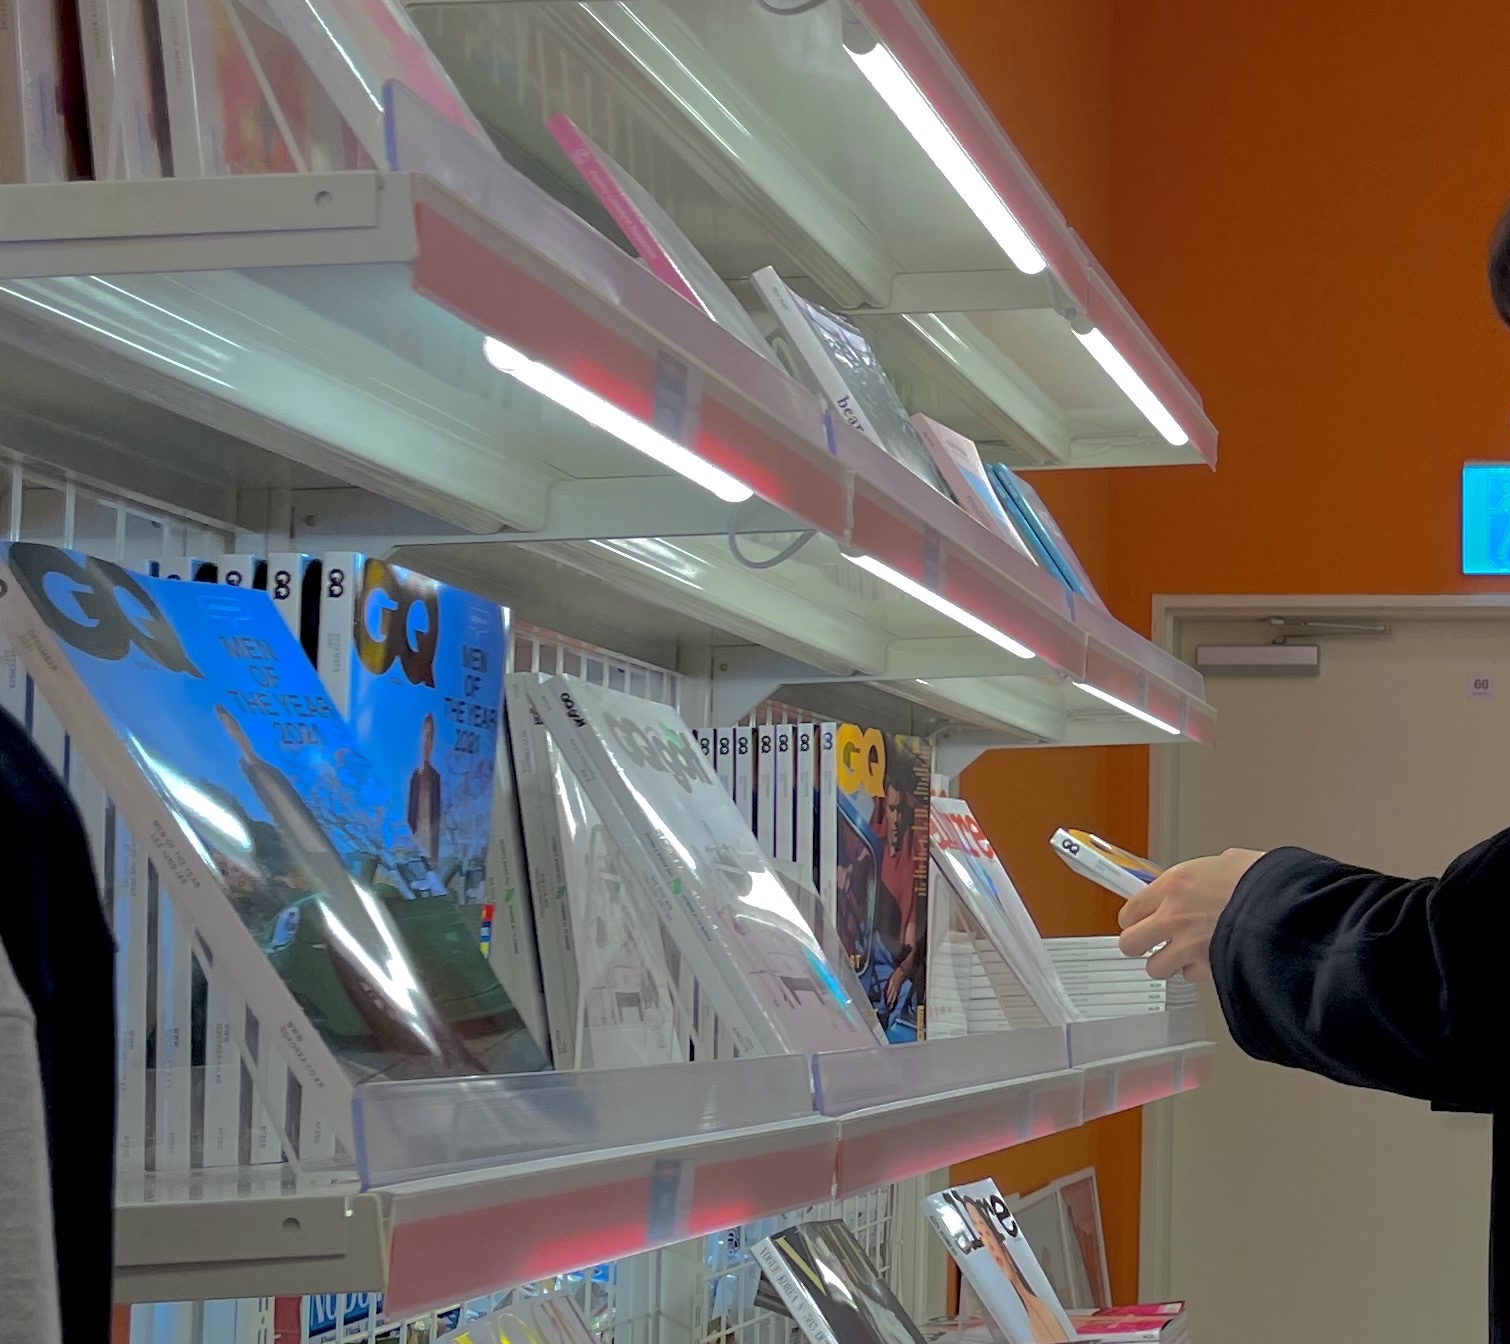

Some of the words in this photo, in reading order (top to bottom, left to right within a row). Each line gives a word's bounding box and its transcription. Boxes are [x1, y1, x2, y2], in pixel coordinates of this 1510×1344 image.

[837, 395, 865, 434] bear
[274, 570, 291, 600] GQ
[328, 568, 345, 599] GQ
[8, 541, 207, 681] GQ
[354, 557, 440, 688] GQ
[836, 722, 887, 798] GQ
[1061, 838, 1081, 856] GQ
[776, 1273, 799, 1303] KOREA
